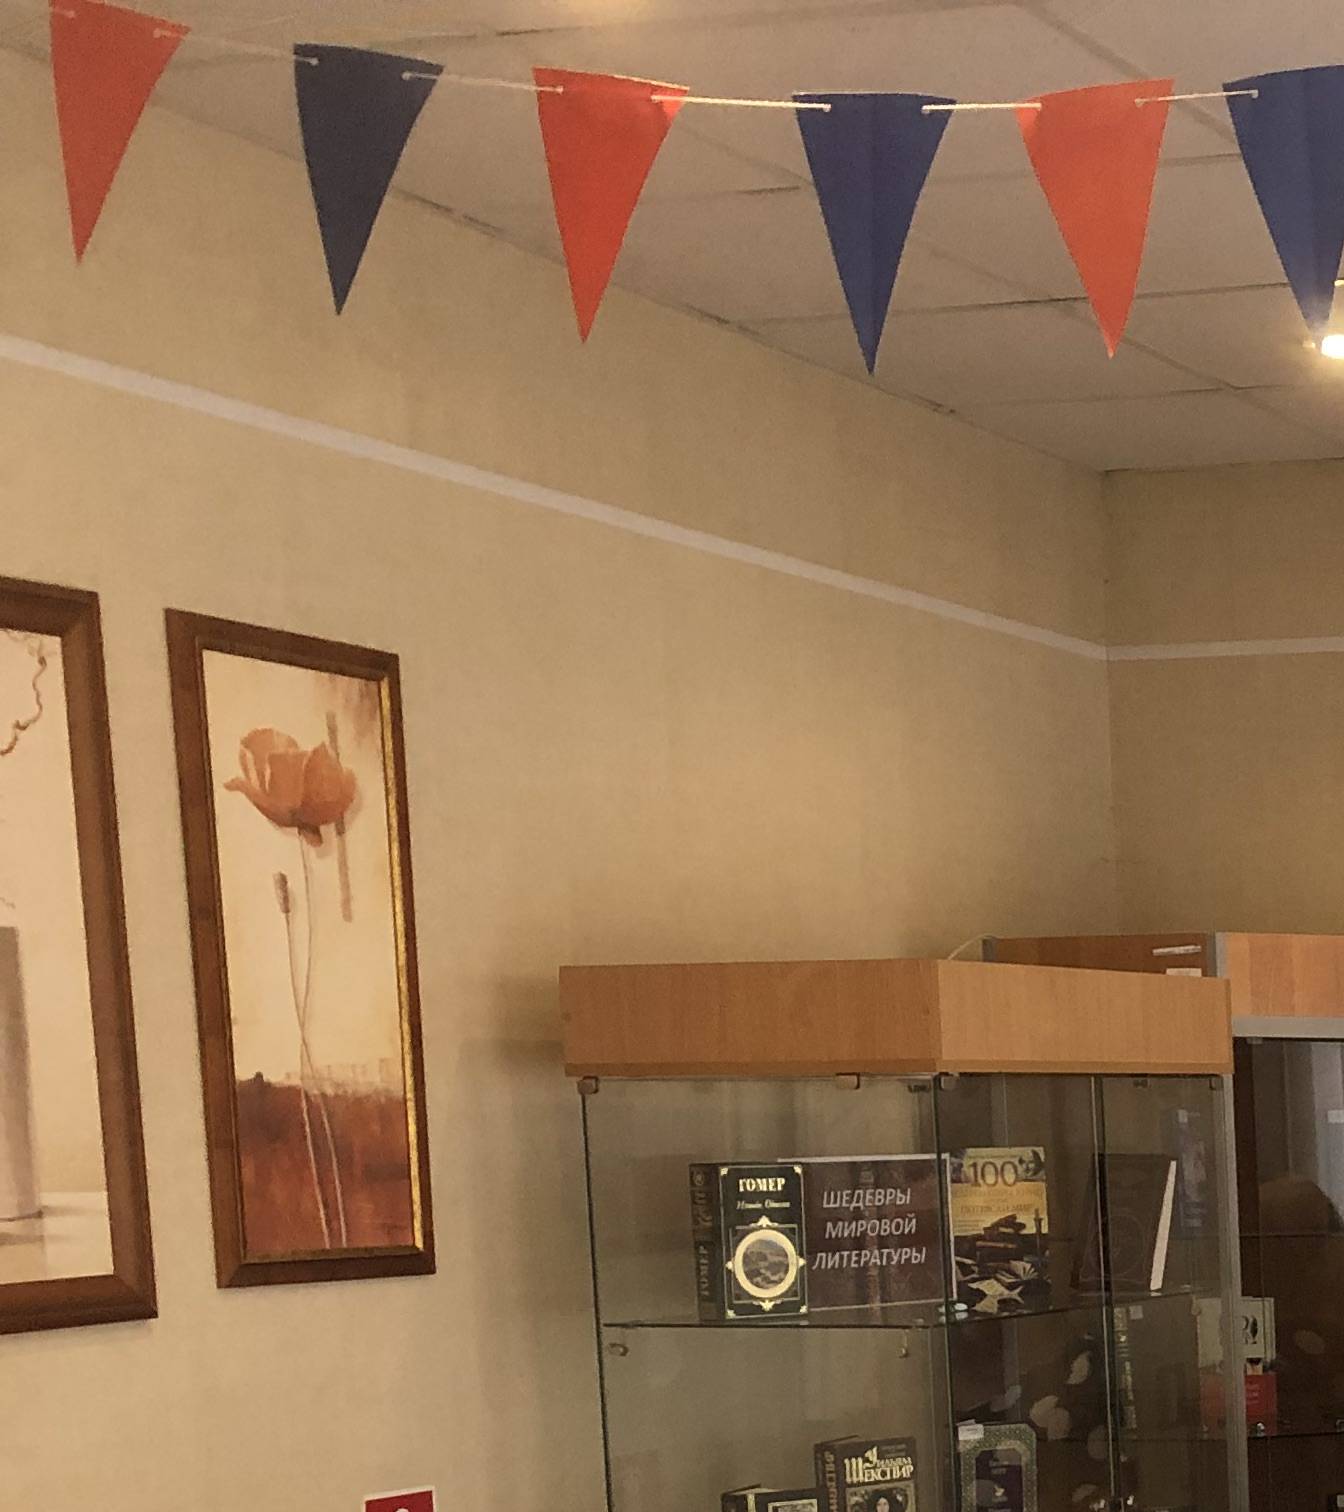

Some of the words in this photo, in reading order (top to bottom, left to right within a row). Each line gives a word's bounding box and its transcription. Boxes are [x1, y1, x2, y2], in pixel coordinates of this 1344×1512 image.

[738, 1177, 786, 1192] ГОМЕР
[968, 1160, 1019, 1187] 100
[822, 1187, 911, 1210] ШЕДЕВРЫ
[825, 1213, 917, 1239] МИРОВОЙ
[812, 1247, 926, 1270] ЛИТЕРАТУРЫ
